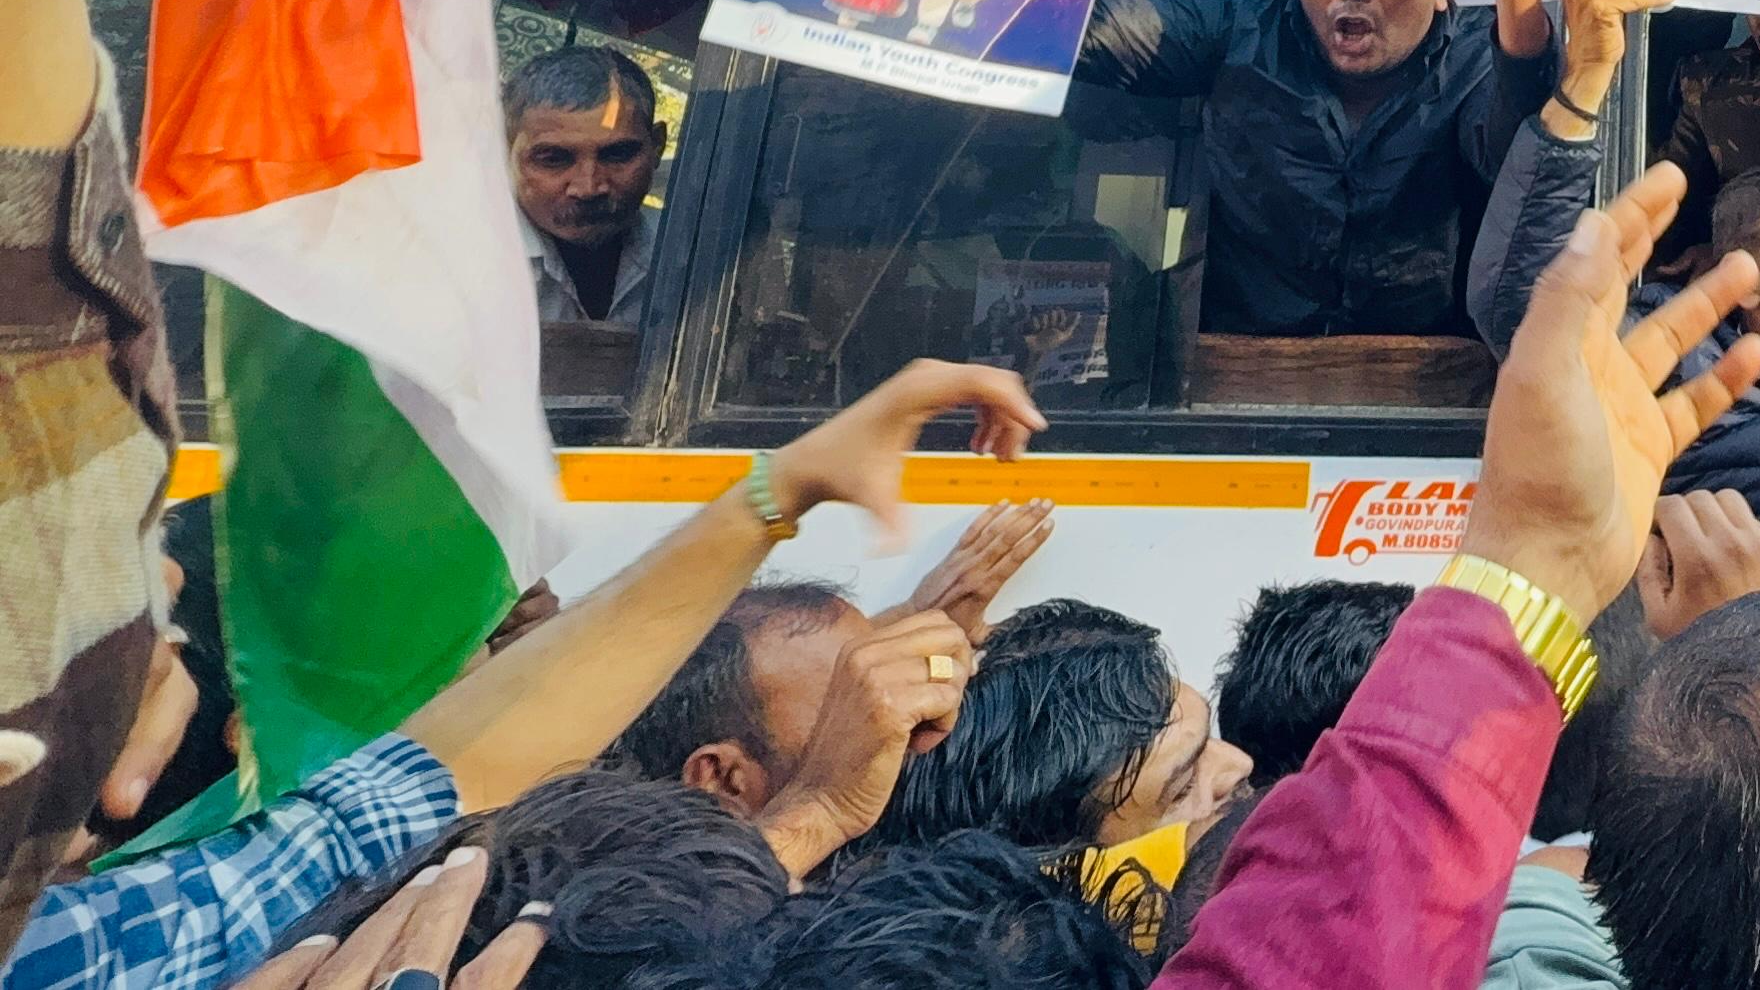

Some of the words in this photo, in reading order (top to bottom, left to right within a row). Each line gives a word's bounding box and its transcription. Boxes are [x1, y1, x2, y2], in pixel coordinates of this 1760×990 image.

[802, 24, 872, 54] Indian
[879, 42, 939, 70] Youth
[946, 62, 1041, 91] Congress
[1367, 502, 1439, 516] BODY
[1365, 518, 1466, 531] GOVINDPURA
